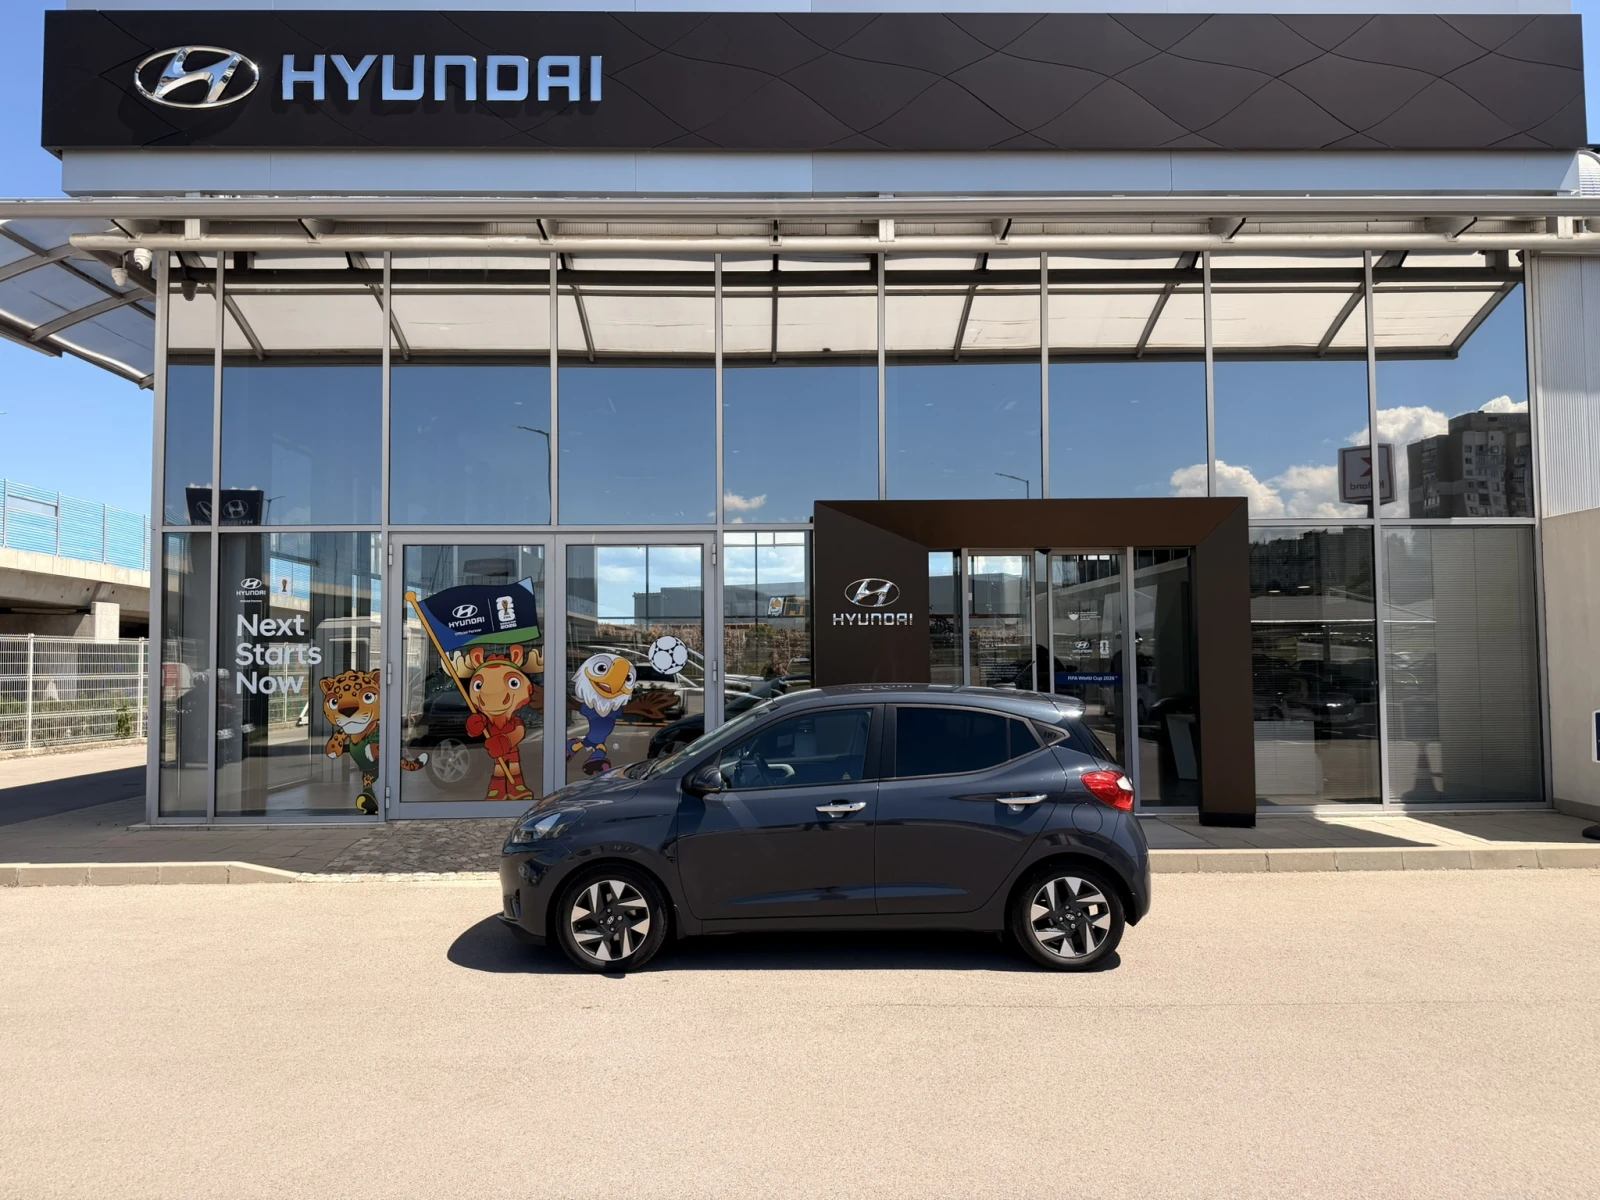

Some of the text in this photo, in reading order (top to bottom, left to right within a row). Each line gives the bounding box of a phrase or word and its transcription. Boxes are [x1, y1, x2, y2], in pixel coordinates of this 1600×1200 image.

[282, 54, 602, 101] HYUNDAI
[237, 614, 305, 636] Next
[448, 616, 485, 628] HYUNDAI
[833, 613, 913, 626] HYUNDAI
[235, 642, 322, 666] Starts
[236, 671, 305, 694] Now
